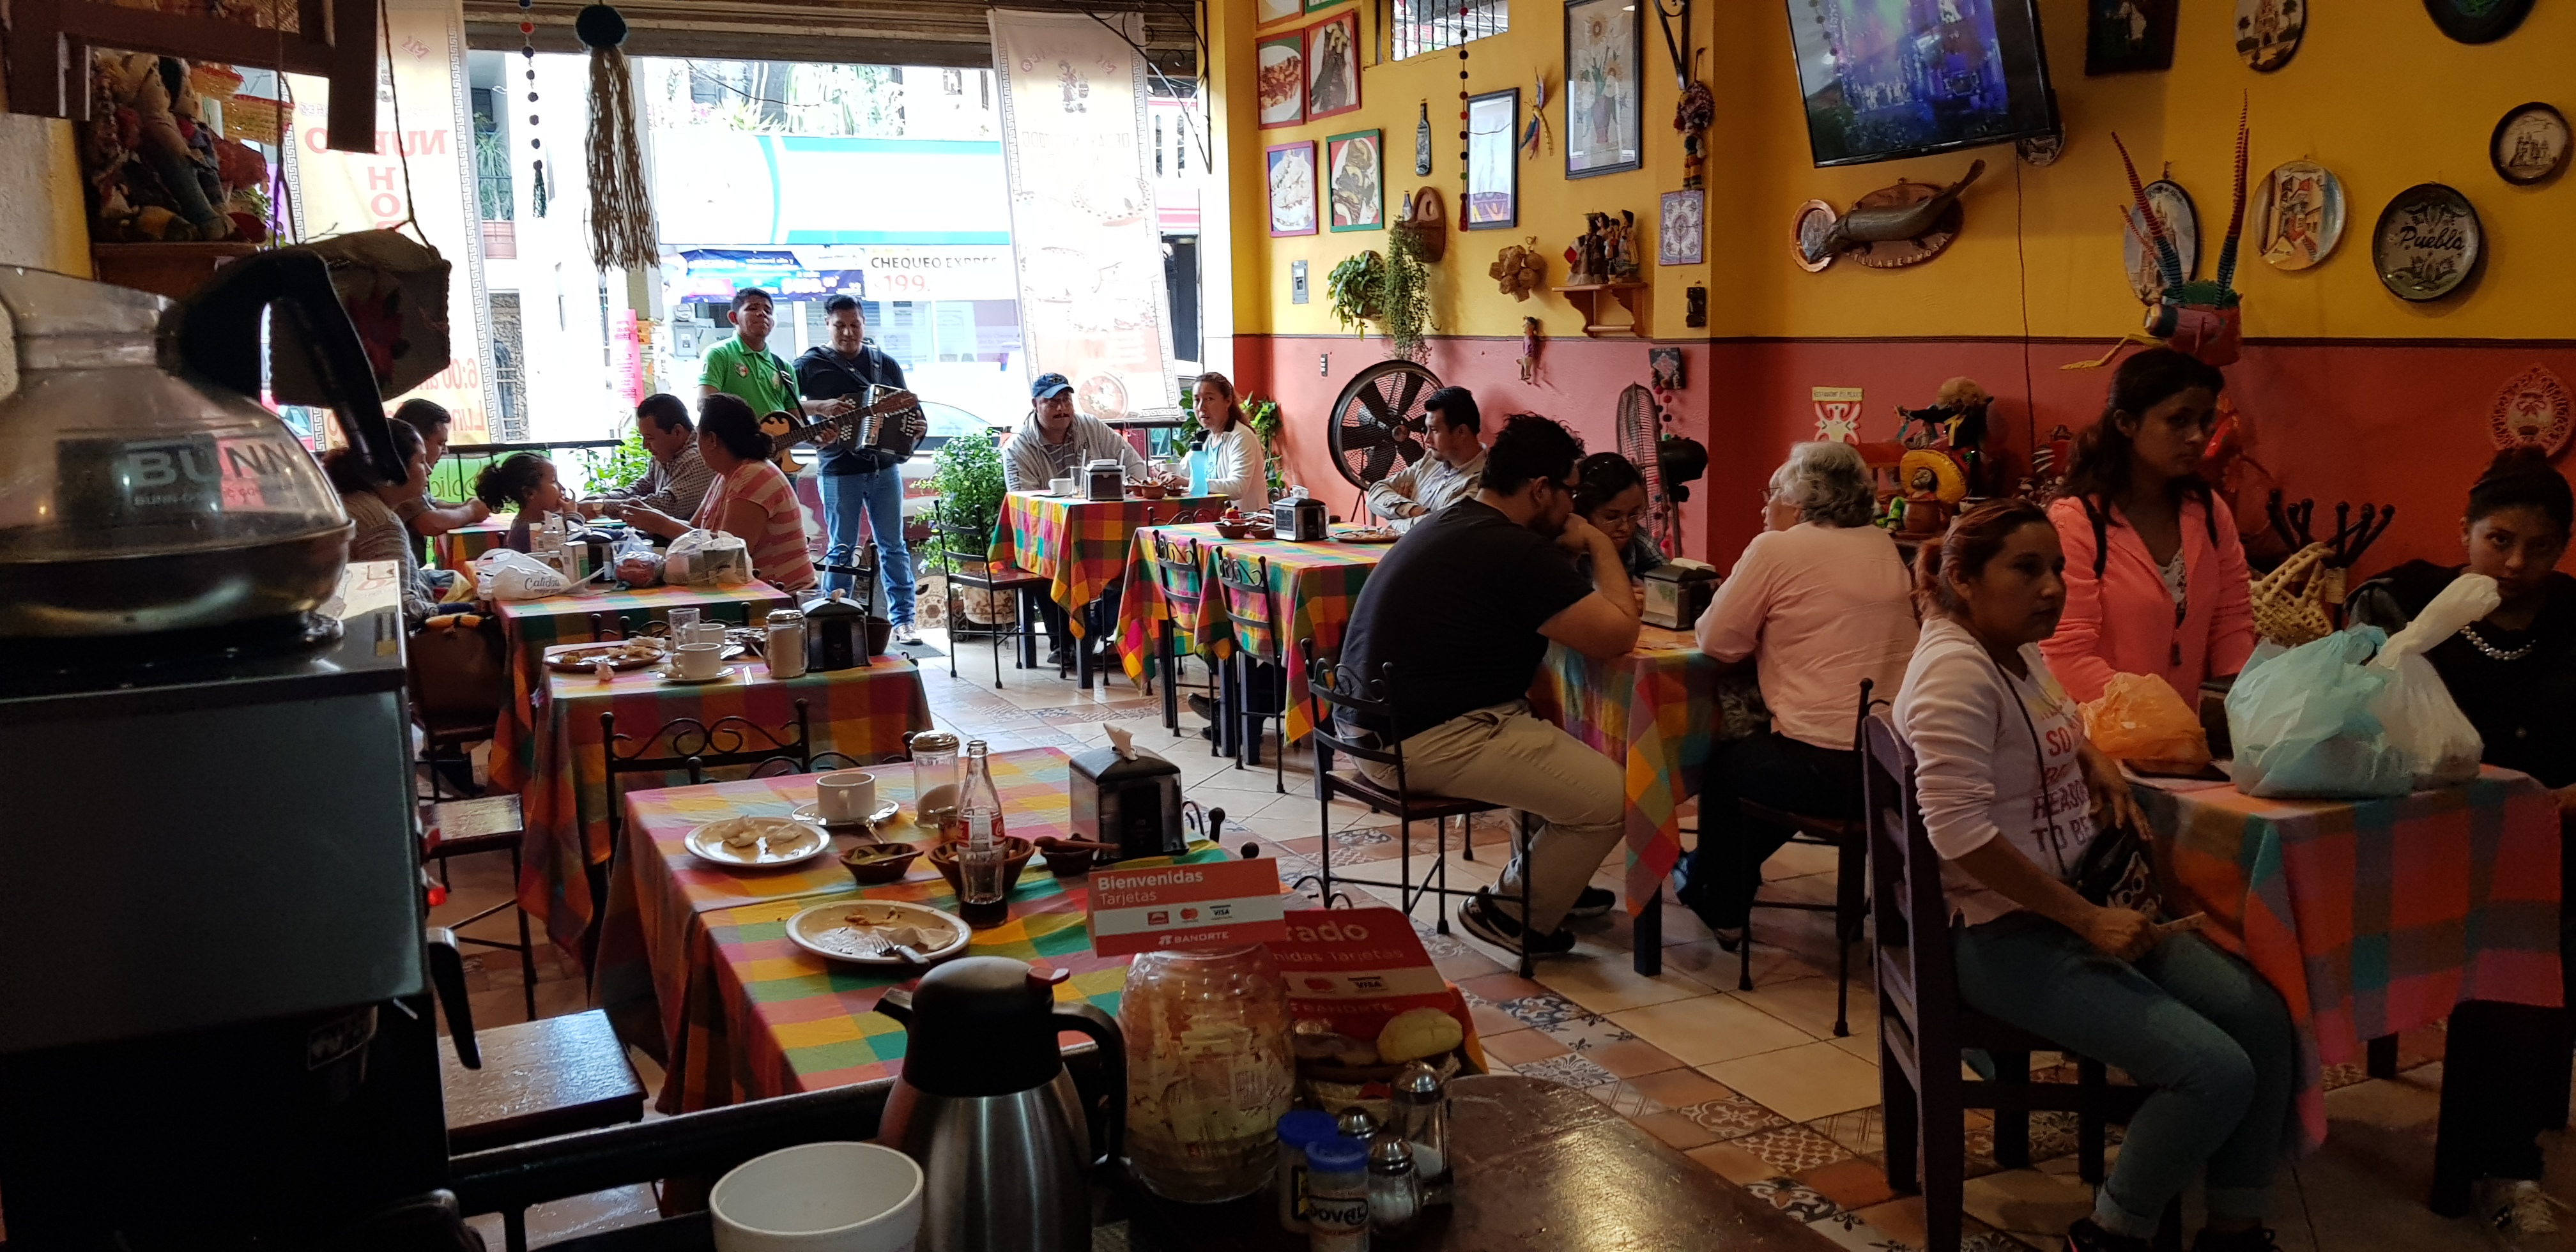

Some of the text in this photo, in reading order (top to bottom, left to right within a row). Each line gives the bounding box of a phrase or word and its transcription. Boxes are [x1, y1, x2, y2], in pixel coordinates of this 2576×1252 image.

[2400, 225, 2464, 250] Puebla
[871, 257, 942, 269] CHEQUEO
[126, 443, 295, 488] BUNN
[2046, 727, 2071, 756] SO
[2030, 825, 2067, 853] TO
[1098, 870, 1204, 891] Bienvenidas
[1100, 890, 1157, 906] Tarjetas
[1174, 931, 1229, 944] BANORTE
[1329, 949, 1404, 963] Tarjetas
